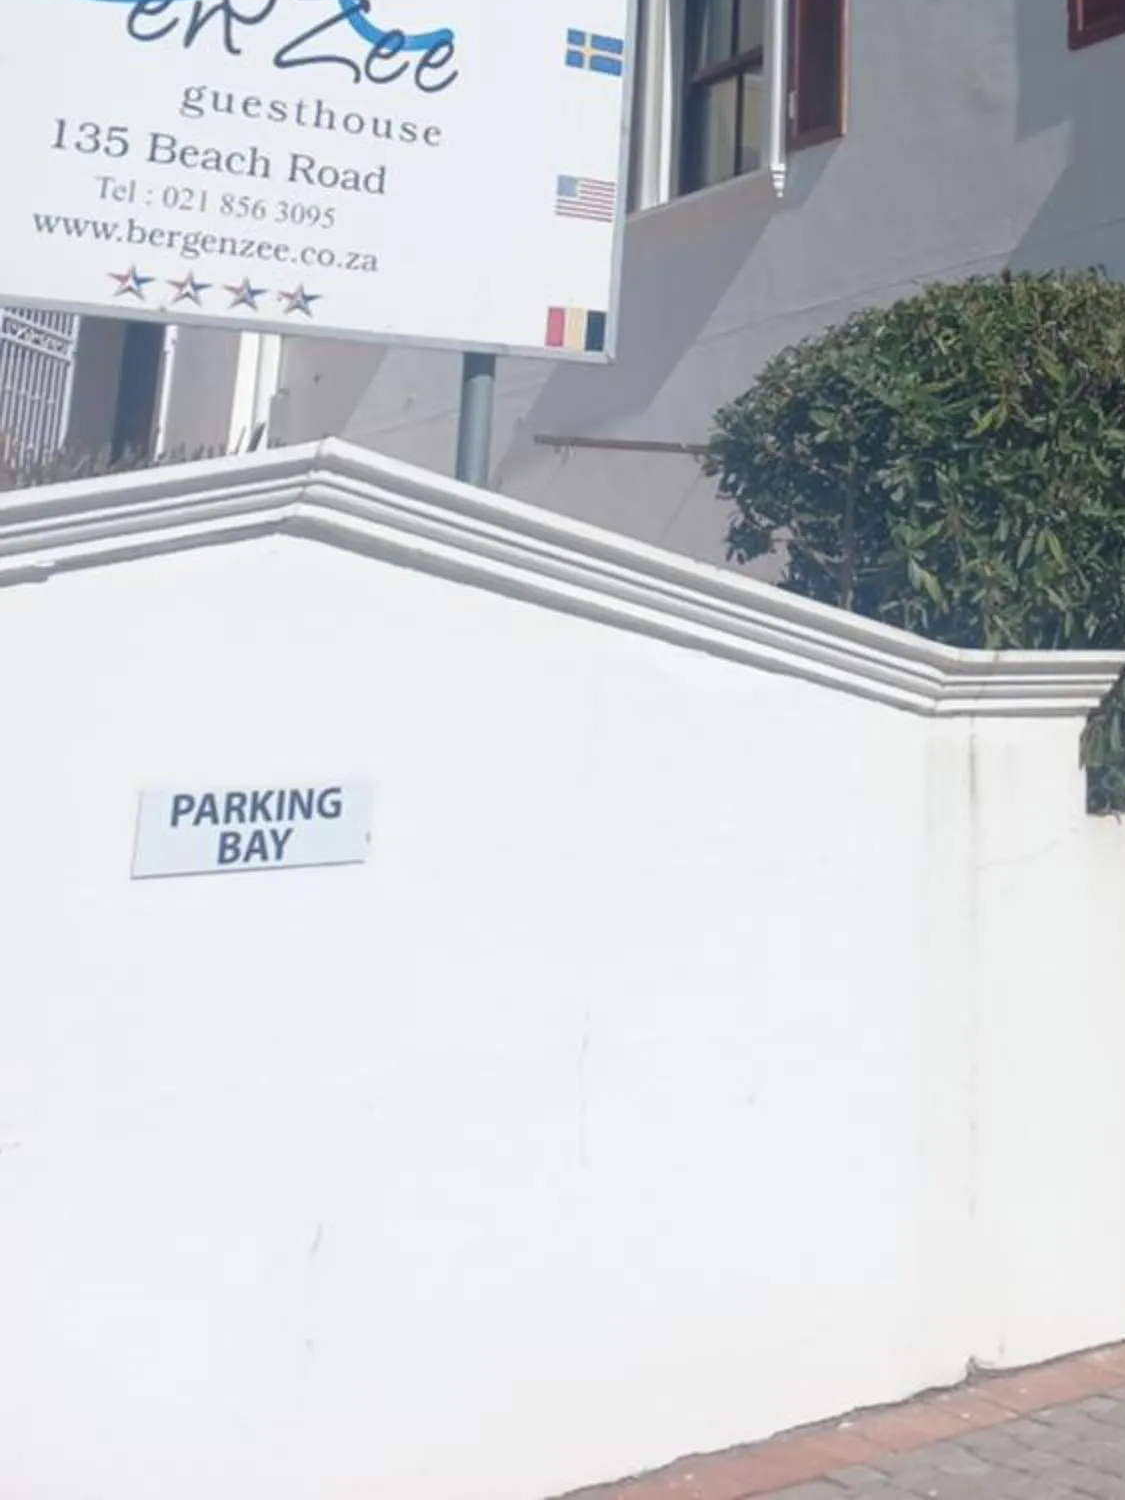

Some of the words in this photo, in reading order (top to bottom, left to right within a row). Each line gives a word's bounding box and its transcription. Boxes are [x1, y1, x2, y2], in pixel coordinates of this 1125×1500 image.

[179, 85, 444, 148] guesthouse
[51, 119, 130, 157] 135
[147, 133, 271, 180] Beach
[287, 153, 388, 196] Road
[96, 176, 137, 205] Tel
[162, 186, 209, 214] 021
[220, 192, 268, 222] 856
[274, 200, 337, 230] 3095
[32, 212, 379, 272] www.bergenzee.co.za
[170, 787, 342, 828] PARKING
[217, 828, 294, 865] BAY
